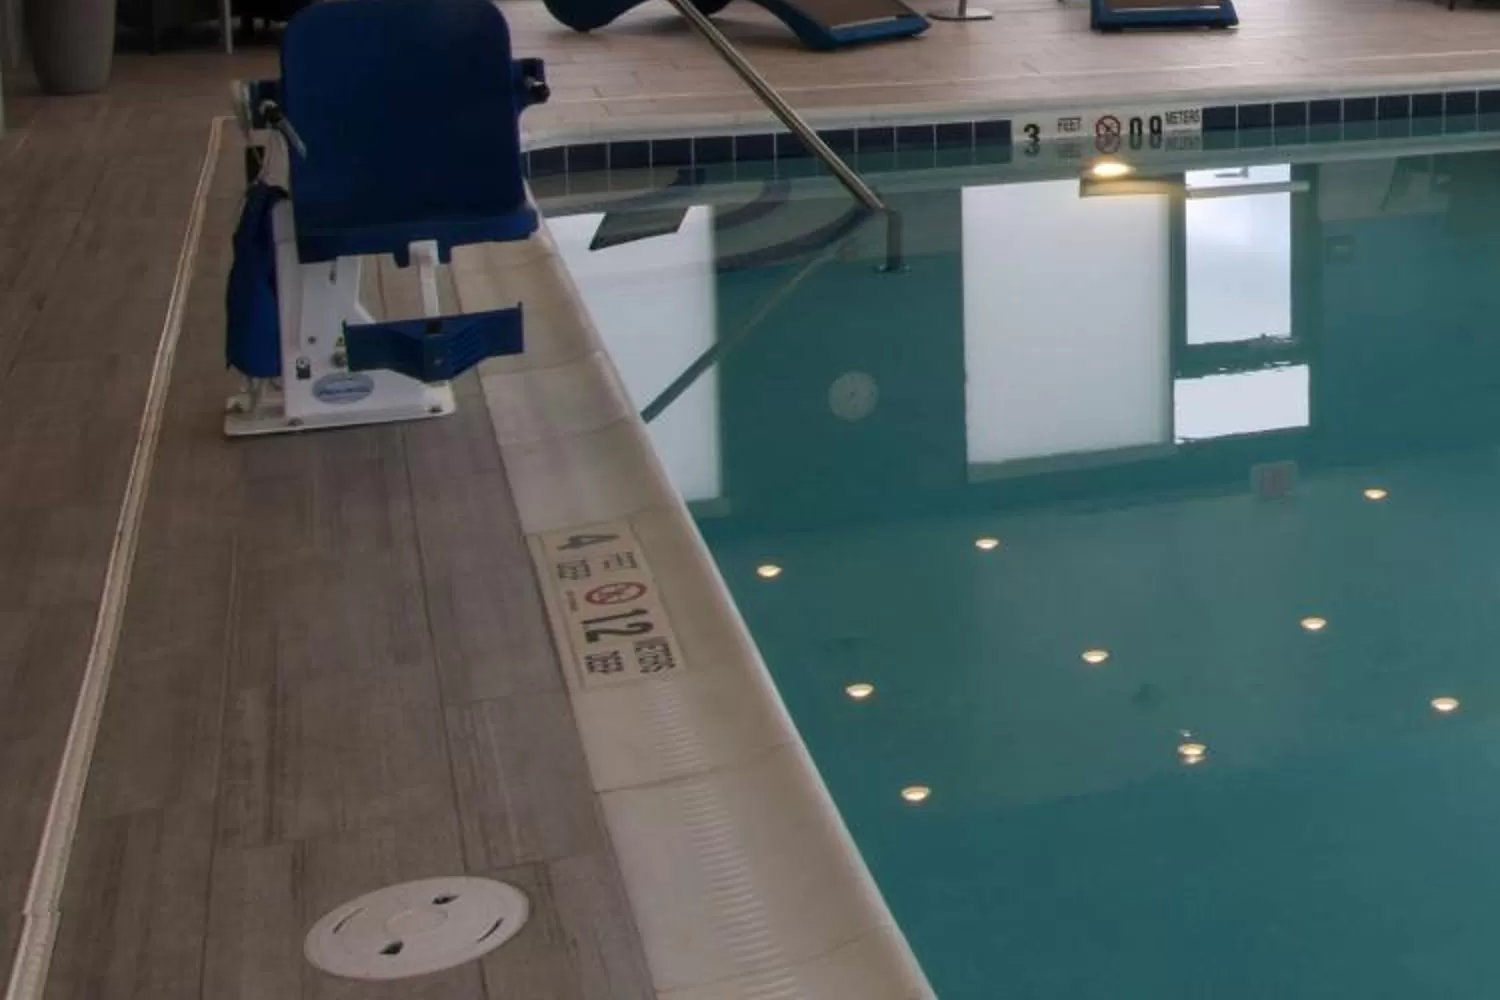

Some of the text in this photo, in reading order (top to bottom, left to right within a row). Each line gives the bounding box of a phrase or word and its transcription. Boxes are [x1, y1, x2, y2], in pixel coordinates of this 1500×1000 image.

[1057, 117, 1082, 133] FEET
[1165, 109, 1200, 126] METERS
[556, 534, 620, 551] 4
